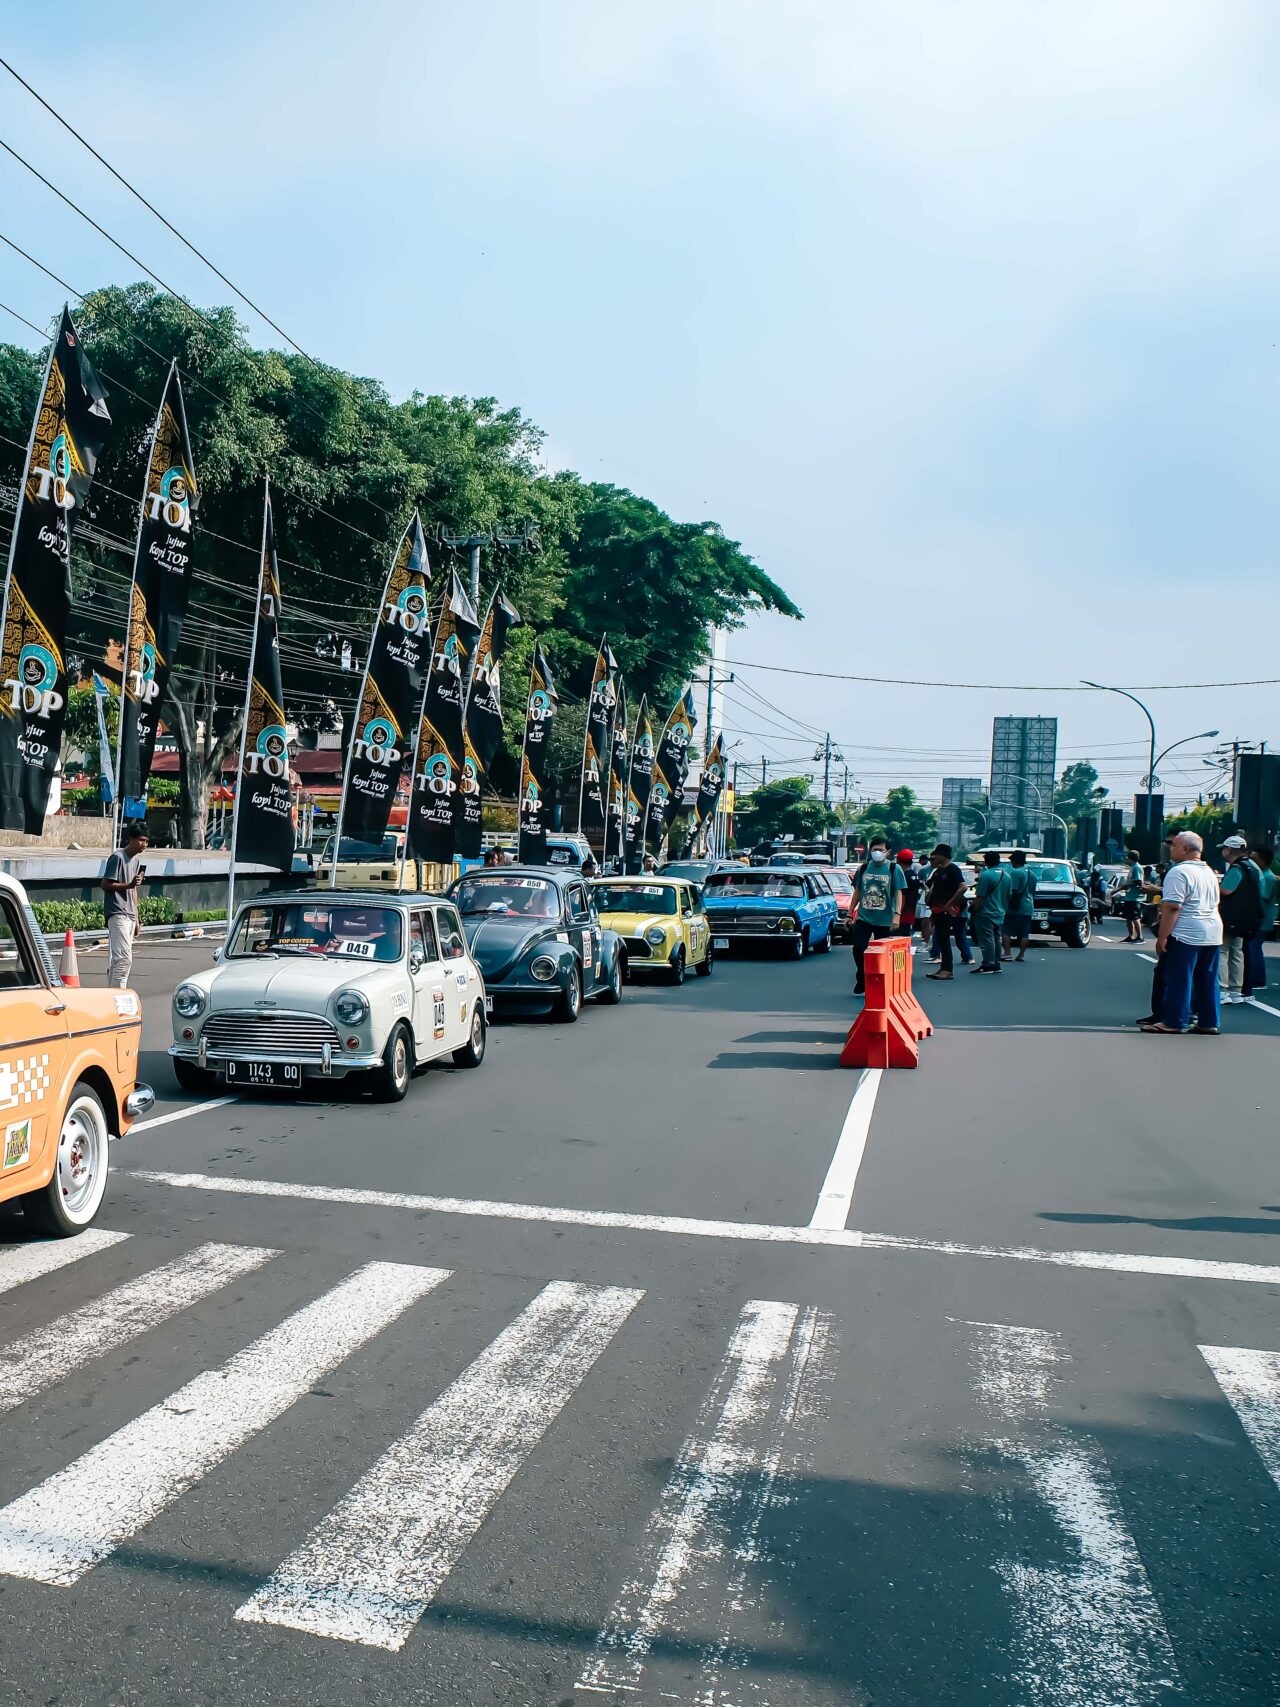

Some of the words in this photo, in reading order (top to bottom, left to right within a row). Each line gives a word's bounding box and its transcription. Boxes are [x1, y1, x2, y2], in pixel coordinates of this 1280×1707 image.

[166, 549, 189, 567] TOP
[402, 648, 420, 663] TOP
[3, 678, 64, 719] TOP
[666, 729, 688, 747] TOP
[354, 738, 401, 767] TOP
[415, 773, 457, 797] TOP
[703, 769, 722, 785] TOP
[370, 781, 390, 793] TOP
[251, 791, 272, 809] kopi
[273, 796, 292, 812] TOP
[437, 808, 453, 819] TOP
[464, 807, 481, 818] TOP
[346, 942, 369, 955] 049
[228, 1062, 236, 1075] D
[248, 1063, 272, 1078] 1143
